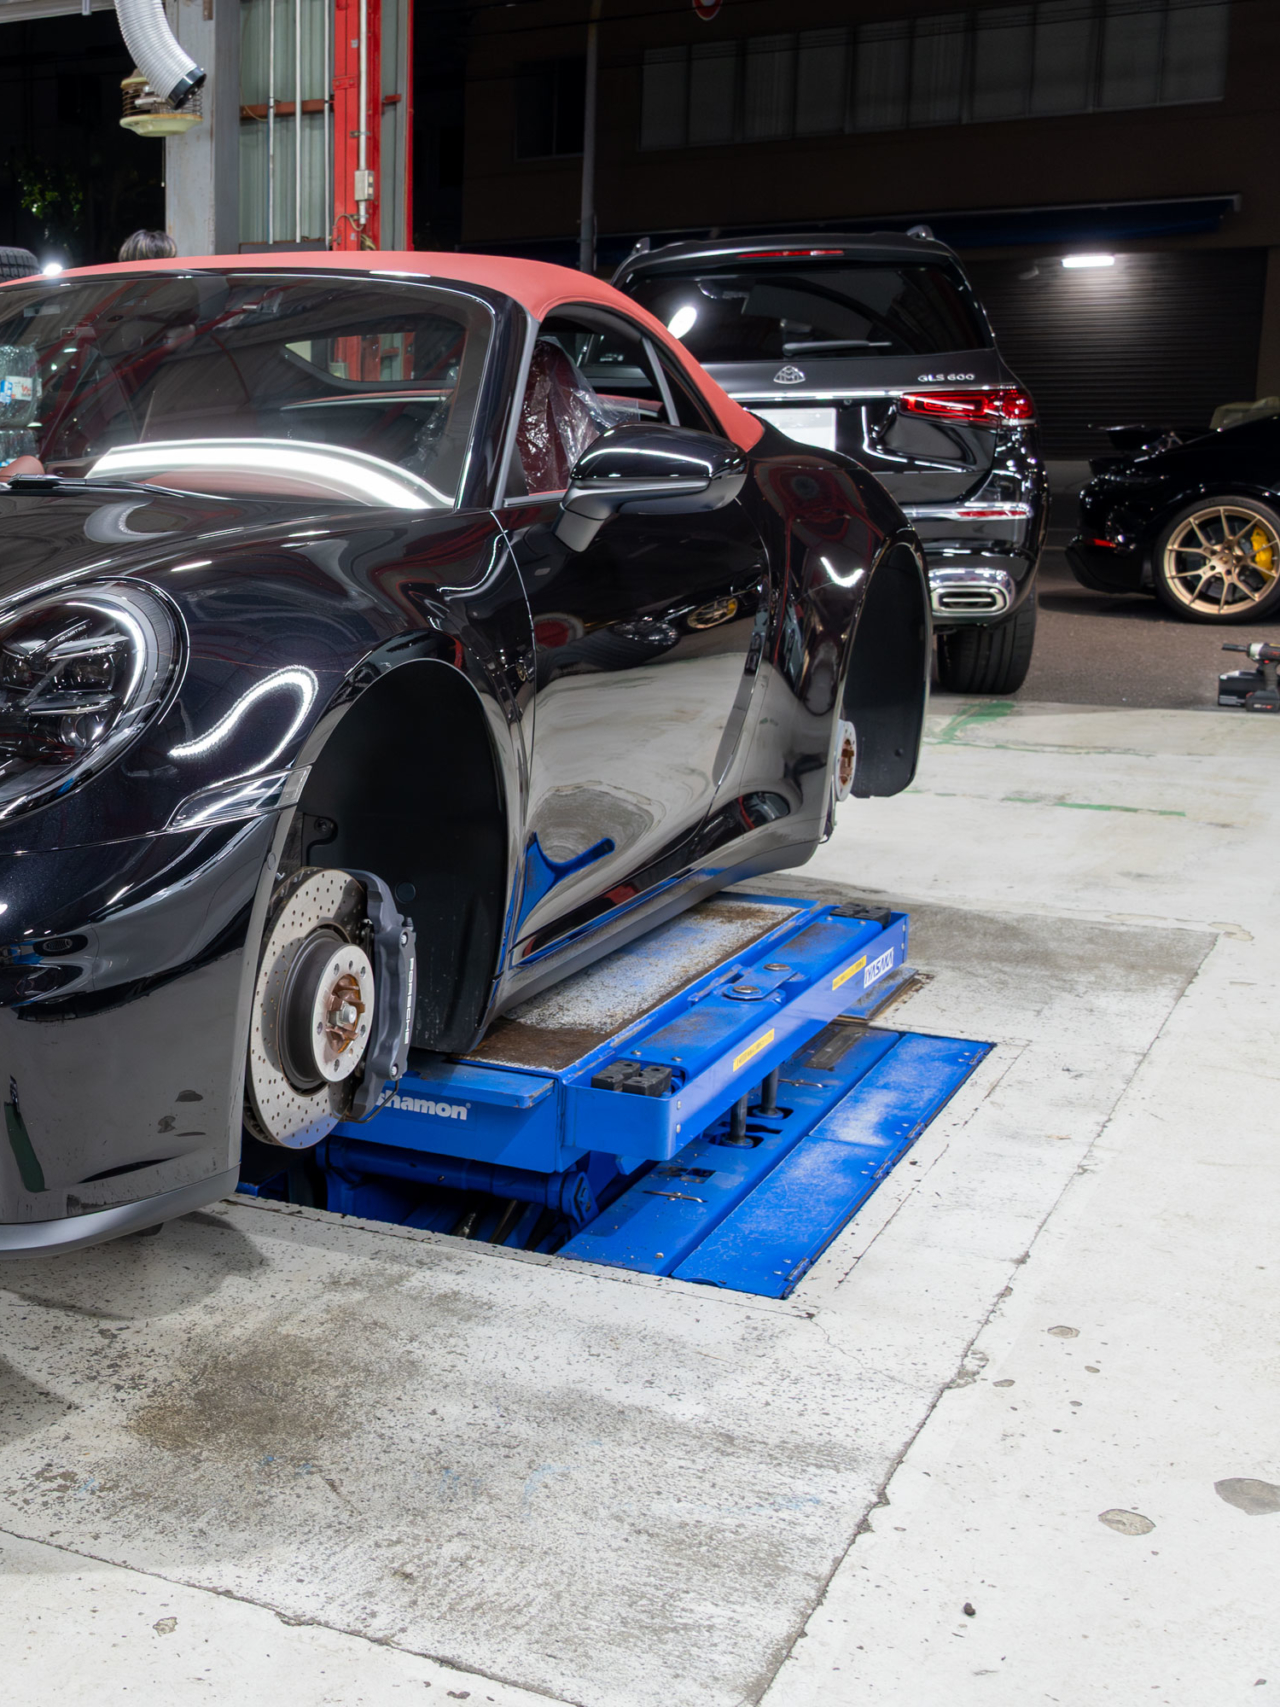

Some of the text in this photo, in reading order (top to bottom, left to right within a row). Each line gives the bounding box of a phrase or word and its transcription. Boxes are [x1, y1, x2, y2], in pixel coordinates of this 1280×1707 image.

[918, 373, 975, 382] GLS 600
[404, 957, 415, 1045] PORSCHE
[375, 1089, 468, 1121] shamon
